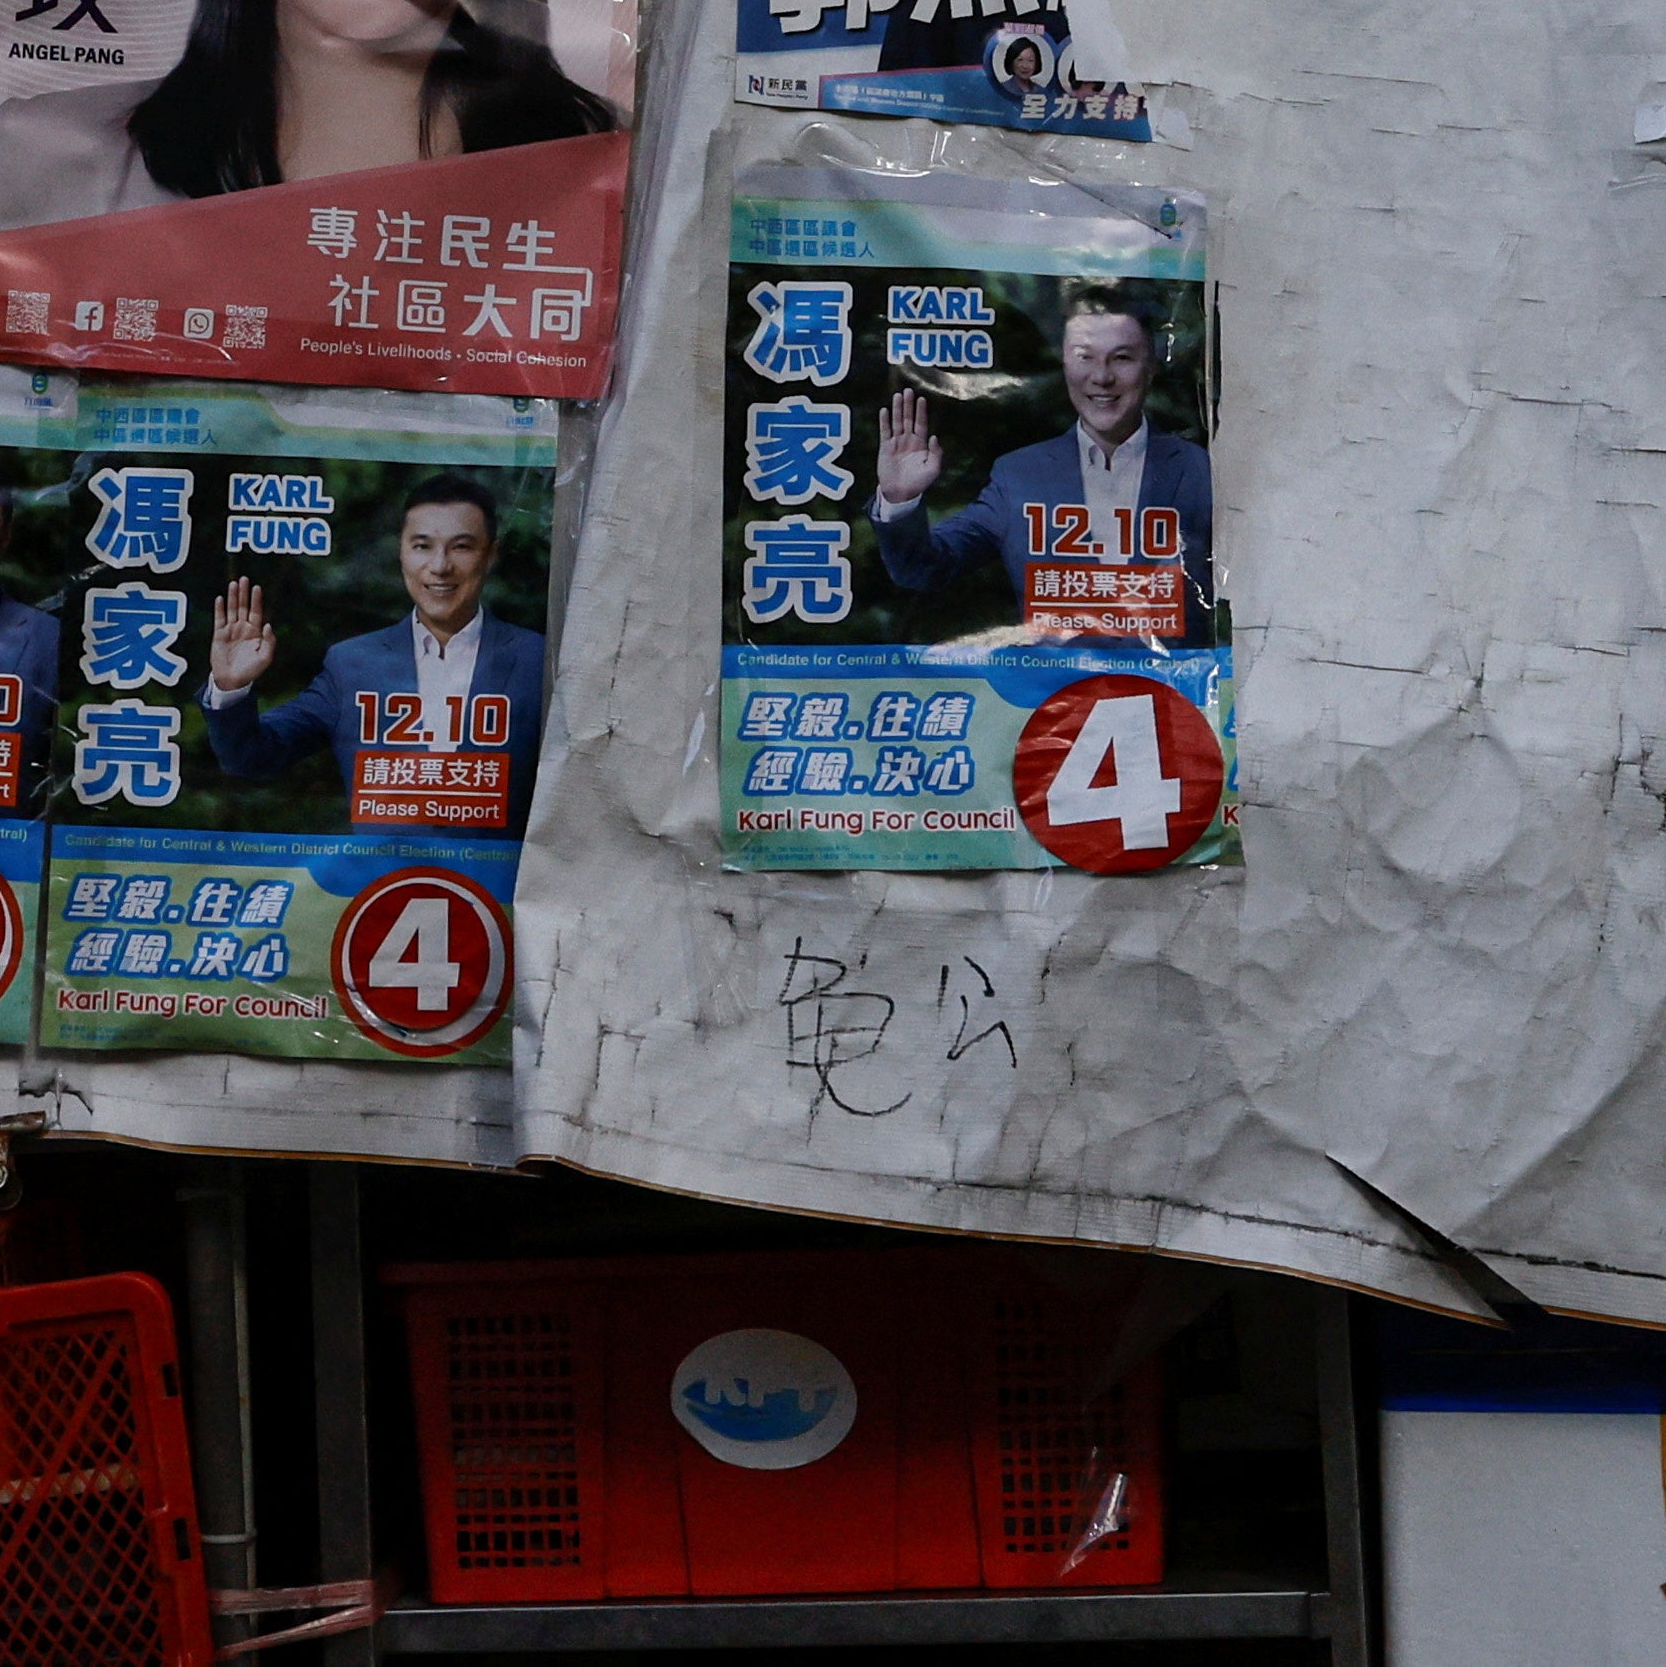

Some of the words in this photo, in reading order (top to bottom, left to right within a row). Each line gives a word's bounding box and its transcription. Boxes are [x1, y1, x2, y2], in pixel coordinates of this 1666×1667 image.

[8, 42, 72, 64] ANGEL
[73, 44, 125, 67] PANG
[1019, 91, 1141, 120] 全力支持
[306, 205, 571, 272] 專注民生
[327, 272, 584, 342] 社區大同
[886, 284, 995, 326] KARL
[300, 336, 365, 358] People's
[367, 341, 453, 363] Livelihoods
[465, 346, 512, 365] Social
[515, 350, 588, 370] Cohesion
[886, 328, 994, 369] FUNG
[741, 279, 855, 625] 馮家亮
[228, 473, 334, 515] KARL
[225, 515, 332, 557] FUNG
[1022, 502, 1181, 560] 12.10
[1033, 569, 1176, 602] 請投票支持
[71, 466, 195, 808] 馮家亮
[355, 690, 512, 747] 12.10
[361, 757, 501, 789] 請投票支持
[1045, 693, 1182, 851] 4
[357, 798, 420, 820] Please
[424, 800, 500, 822] Support
[367, 897, 461, 1012] 4
[56, 989, 112, 1013] Karl
[114, 989, 177, 1020] Fung
[183, 994, 227, 1017] For
[233, 995, 329, 1020] Council
